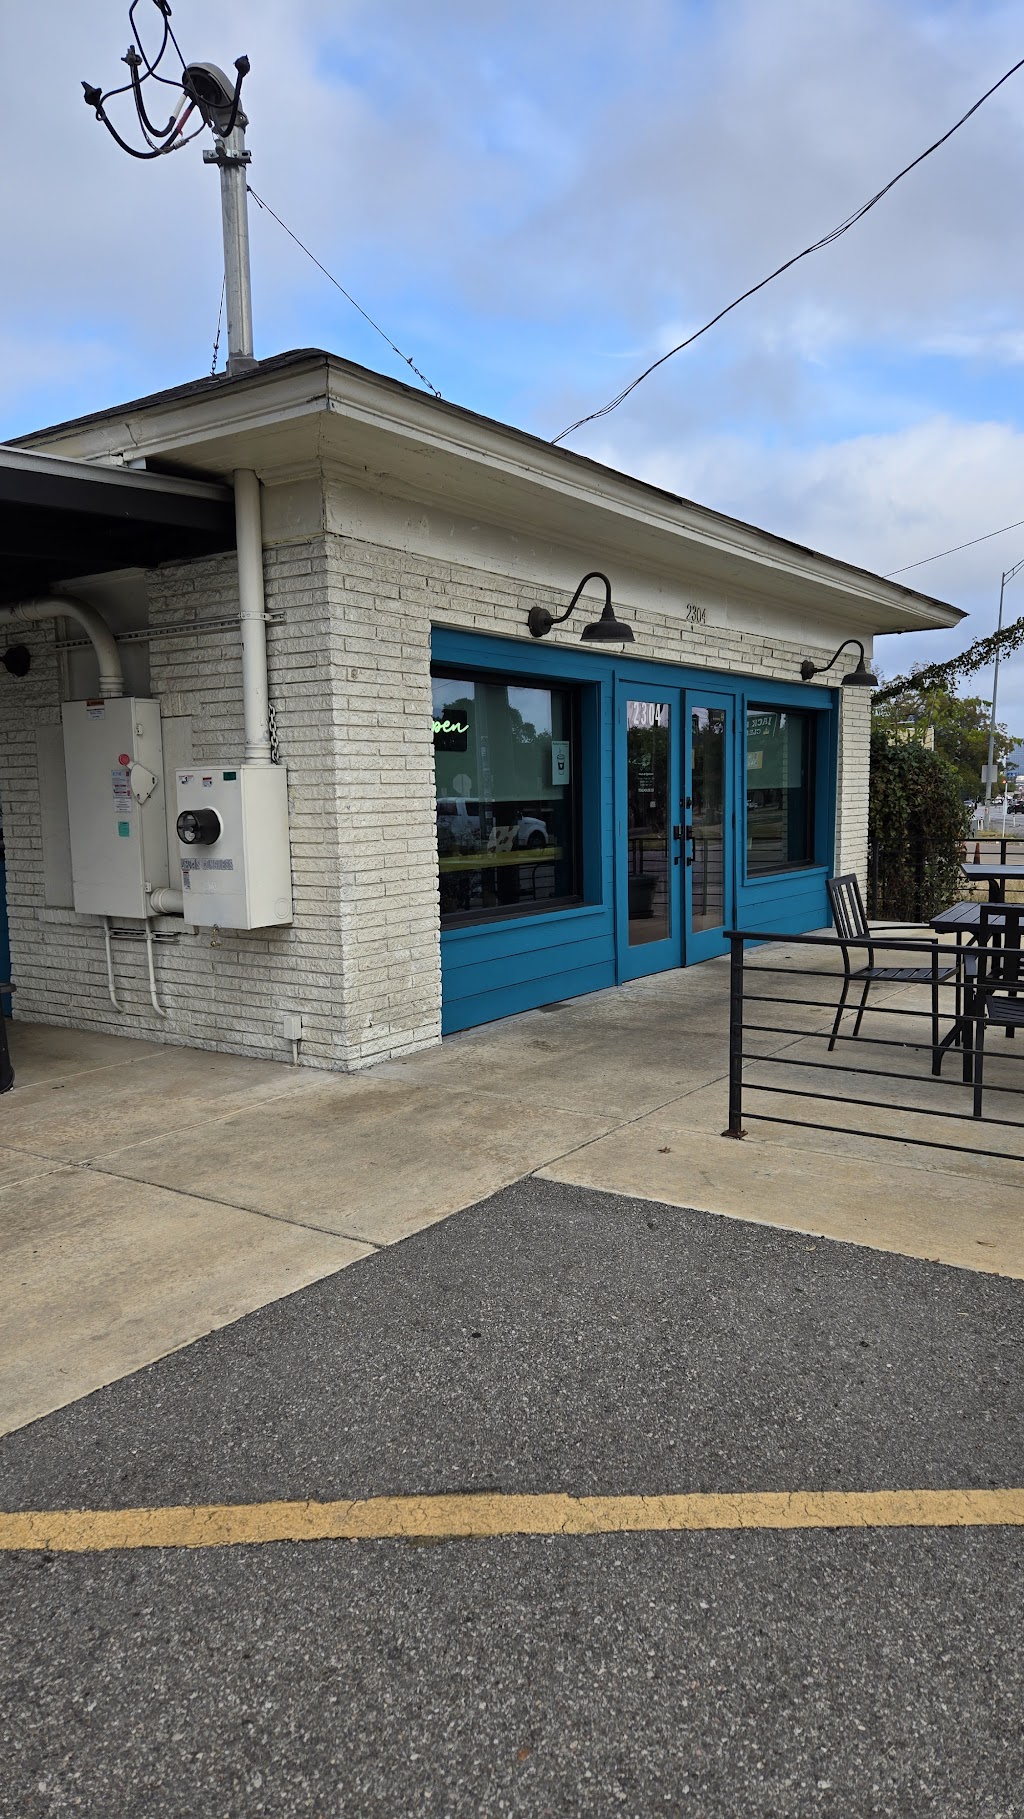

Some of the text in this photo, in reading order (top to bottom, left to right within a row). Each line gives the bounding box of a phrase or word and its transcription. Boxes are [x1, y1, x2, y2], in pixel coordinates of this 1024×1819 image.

[686, 604, 706, 624] 2304
[633, 702, 661, 726] 2304
[431, 720, 469, 733] pen
